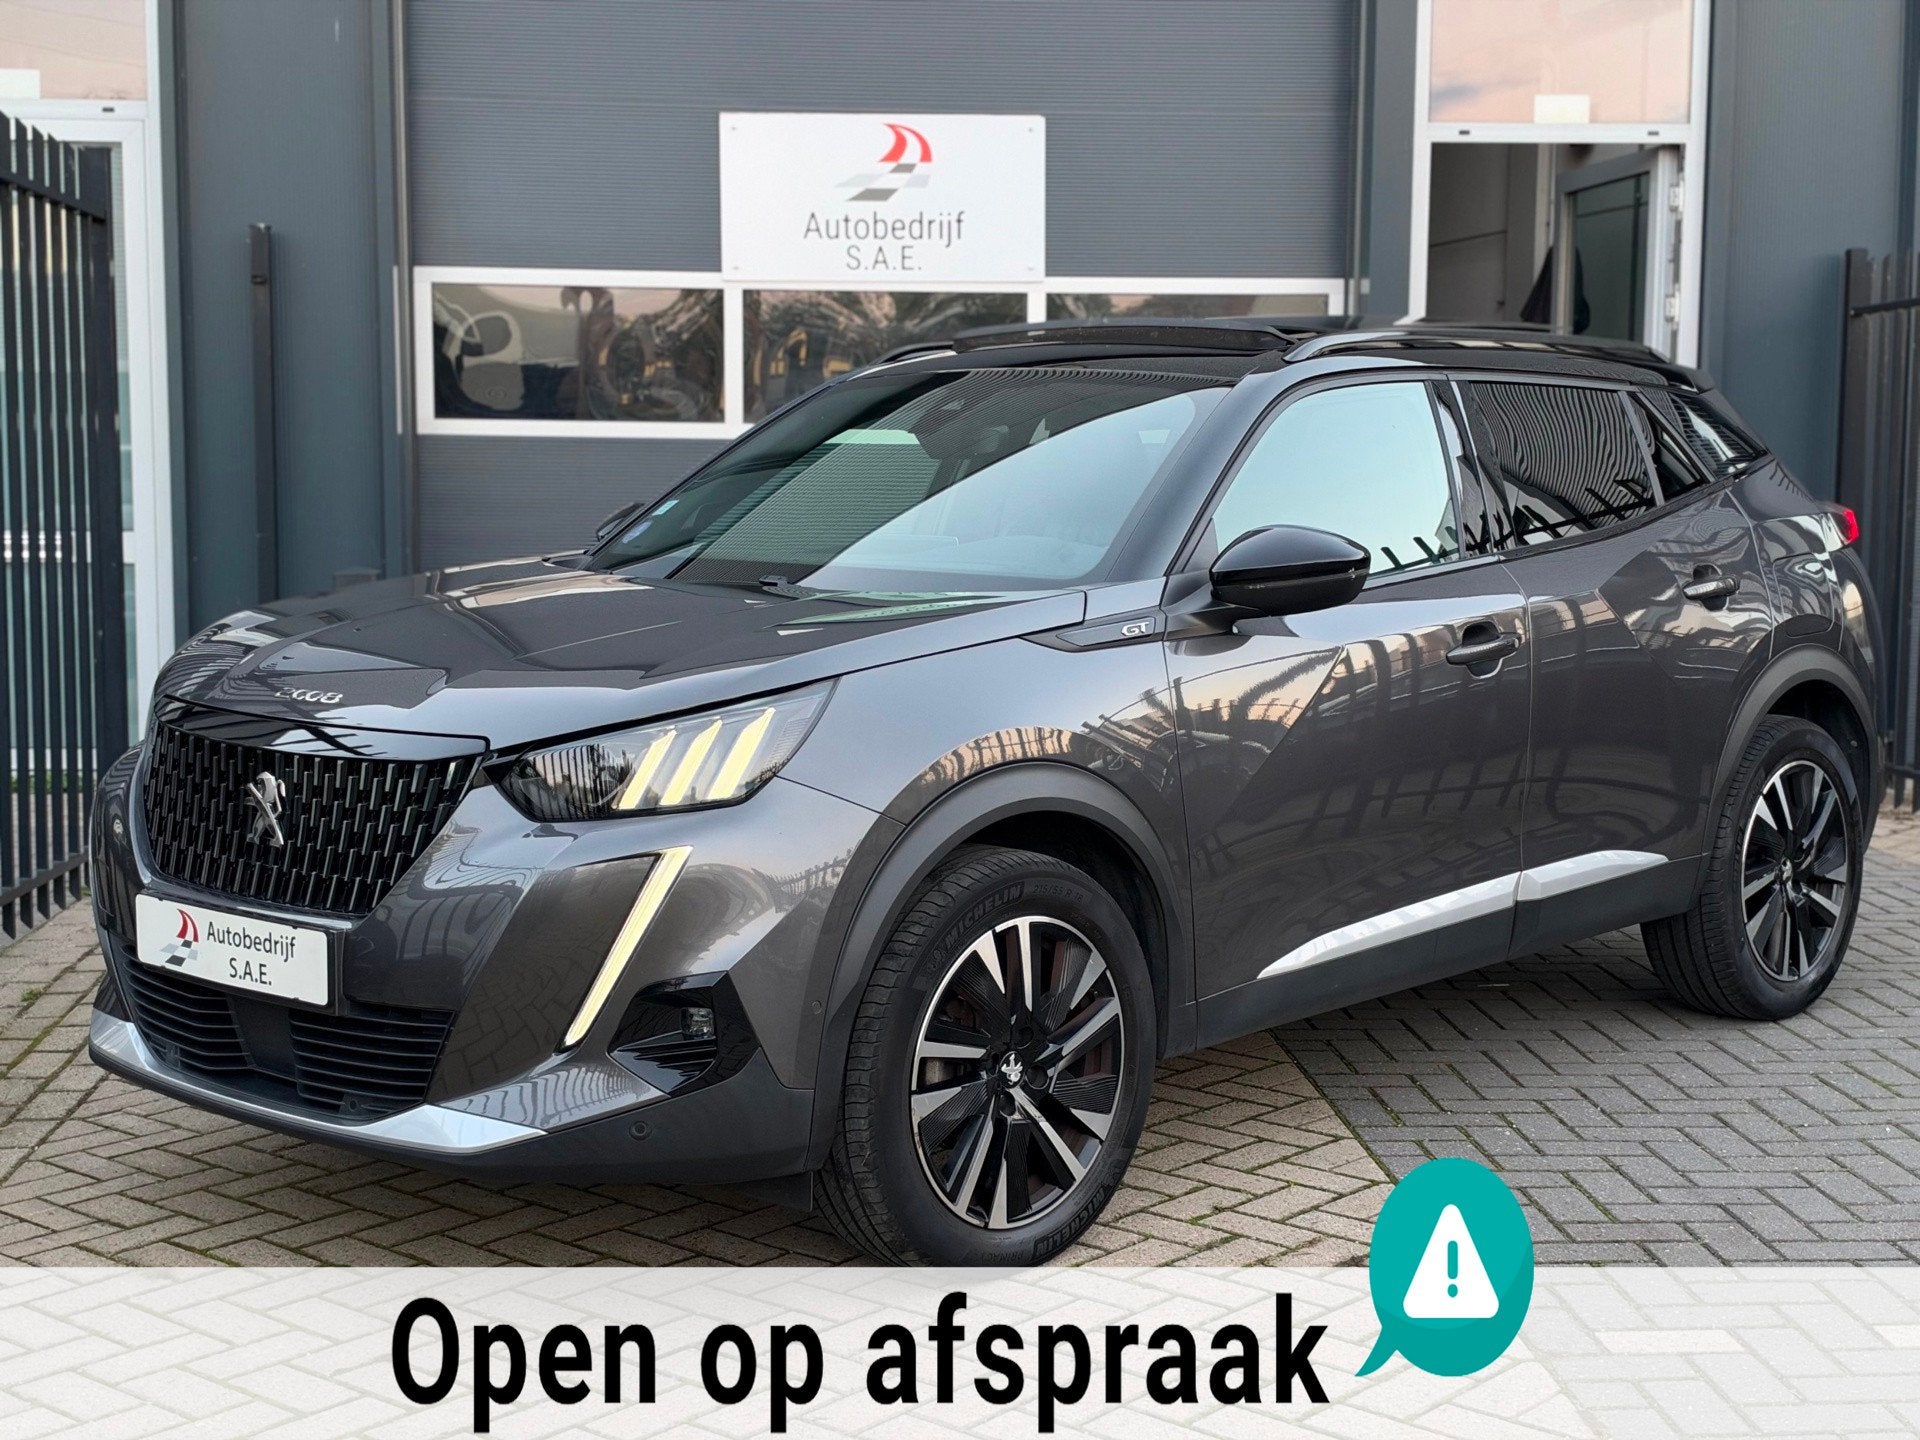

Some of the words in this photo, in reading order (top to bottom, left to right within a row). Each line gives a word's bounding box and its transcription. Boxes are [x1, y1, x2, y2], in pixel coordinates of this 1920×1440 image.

[803, 211, 966, 248] Autobedrijf
[846, 245, 923, 271] S.A.E.
[1120, 621, 1150, 637] GT
[206, 920, 297, 963] Autobedrijf
[228, 957, 273, 987] S.A.E.
